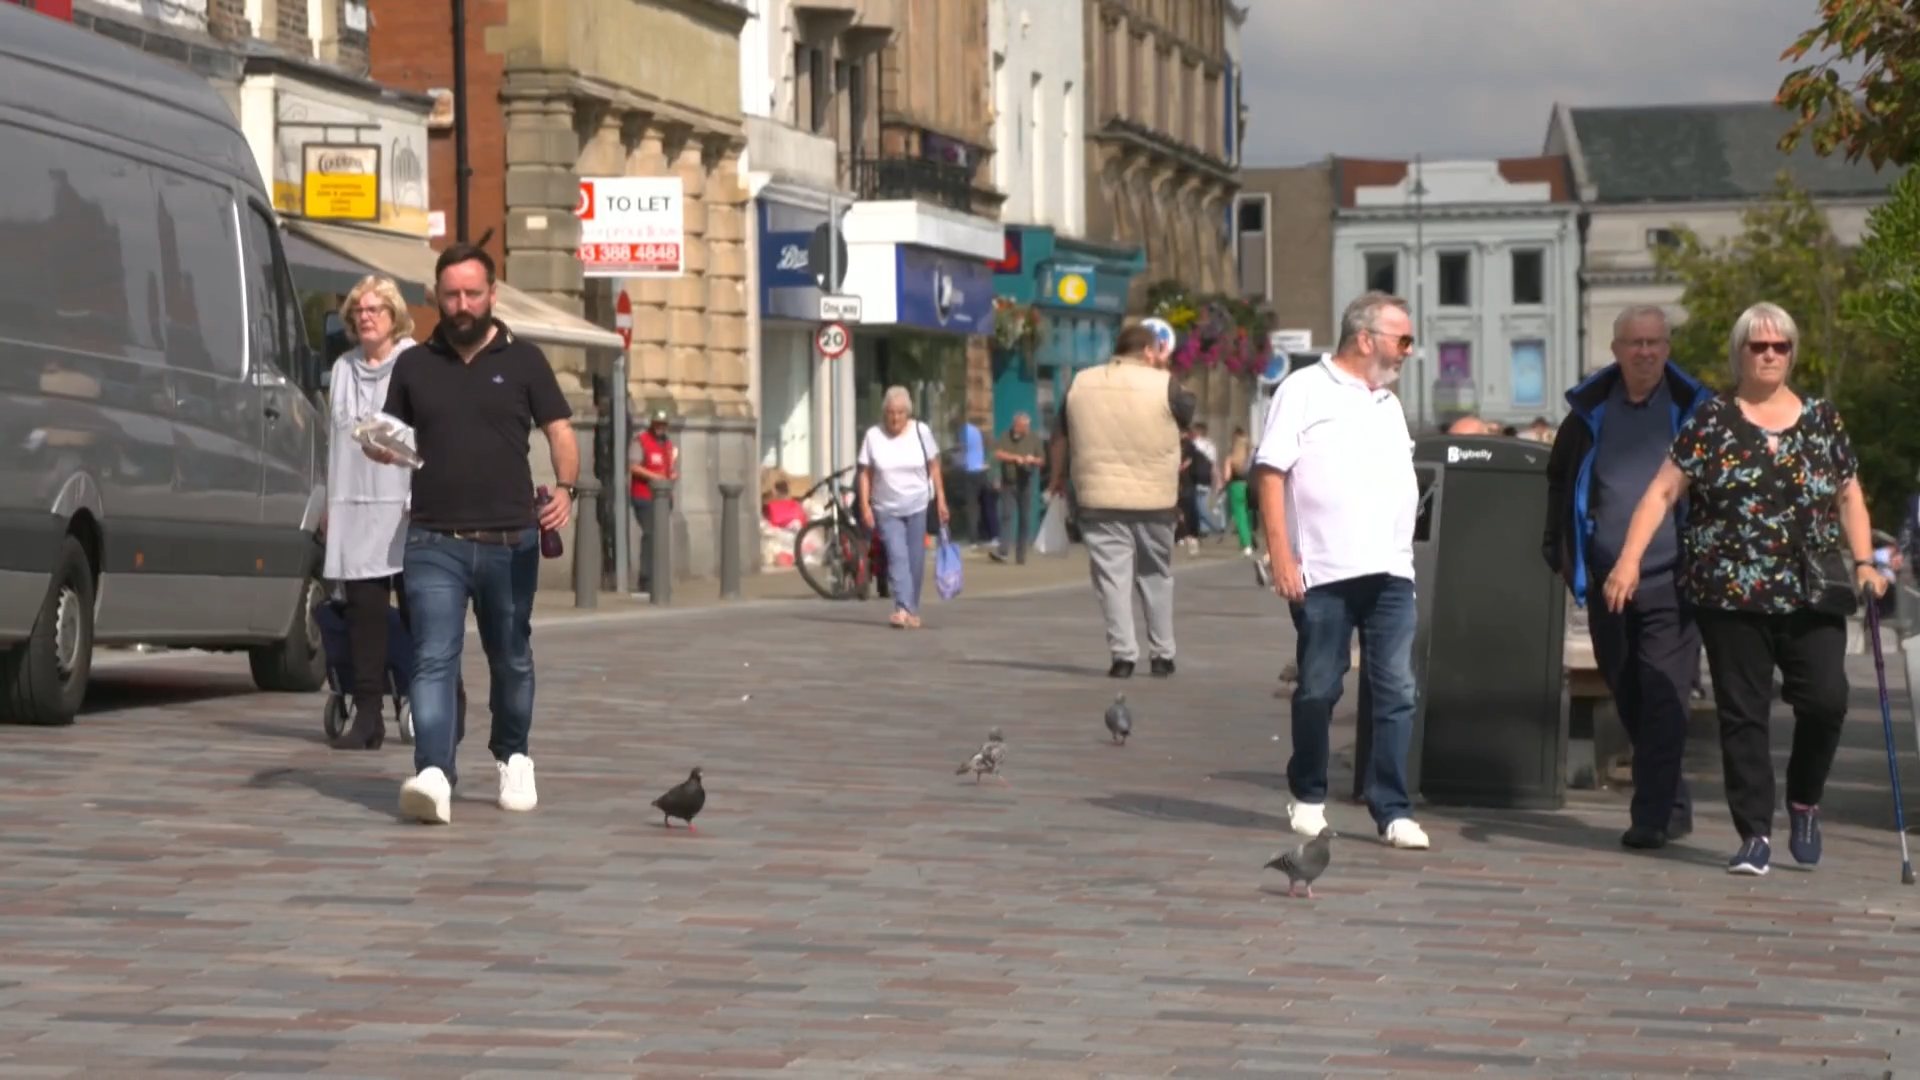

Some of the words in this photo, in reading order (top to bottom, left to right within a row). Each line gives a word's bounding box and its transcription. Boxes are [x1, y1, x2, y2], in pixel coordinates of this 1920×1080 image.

[606, 196, 631, 211] TO
[638, 196, 671, 211] LET
[599, 245, 631, 261] 388
[634, 245, 677, 261] 4848
[823, 302, 839, 313] One
[822, 331, 845, 347] 20
[1448, 446, 1492, 463] Bigbelly
